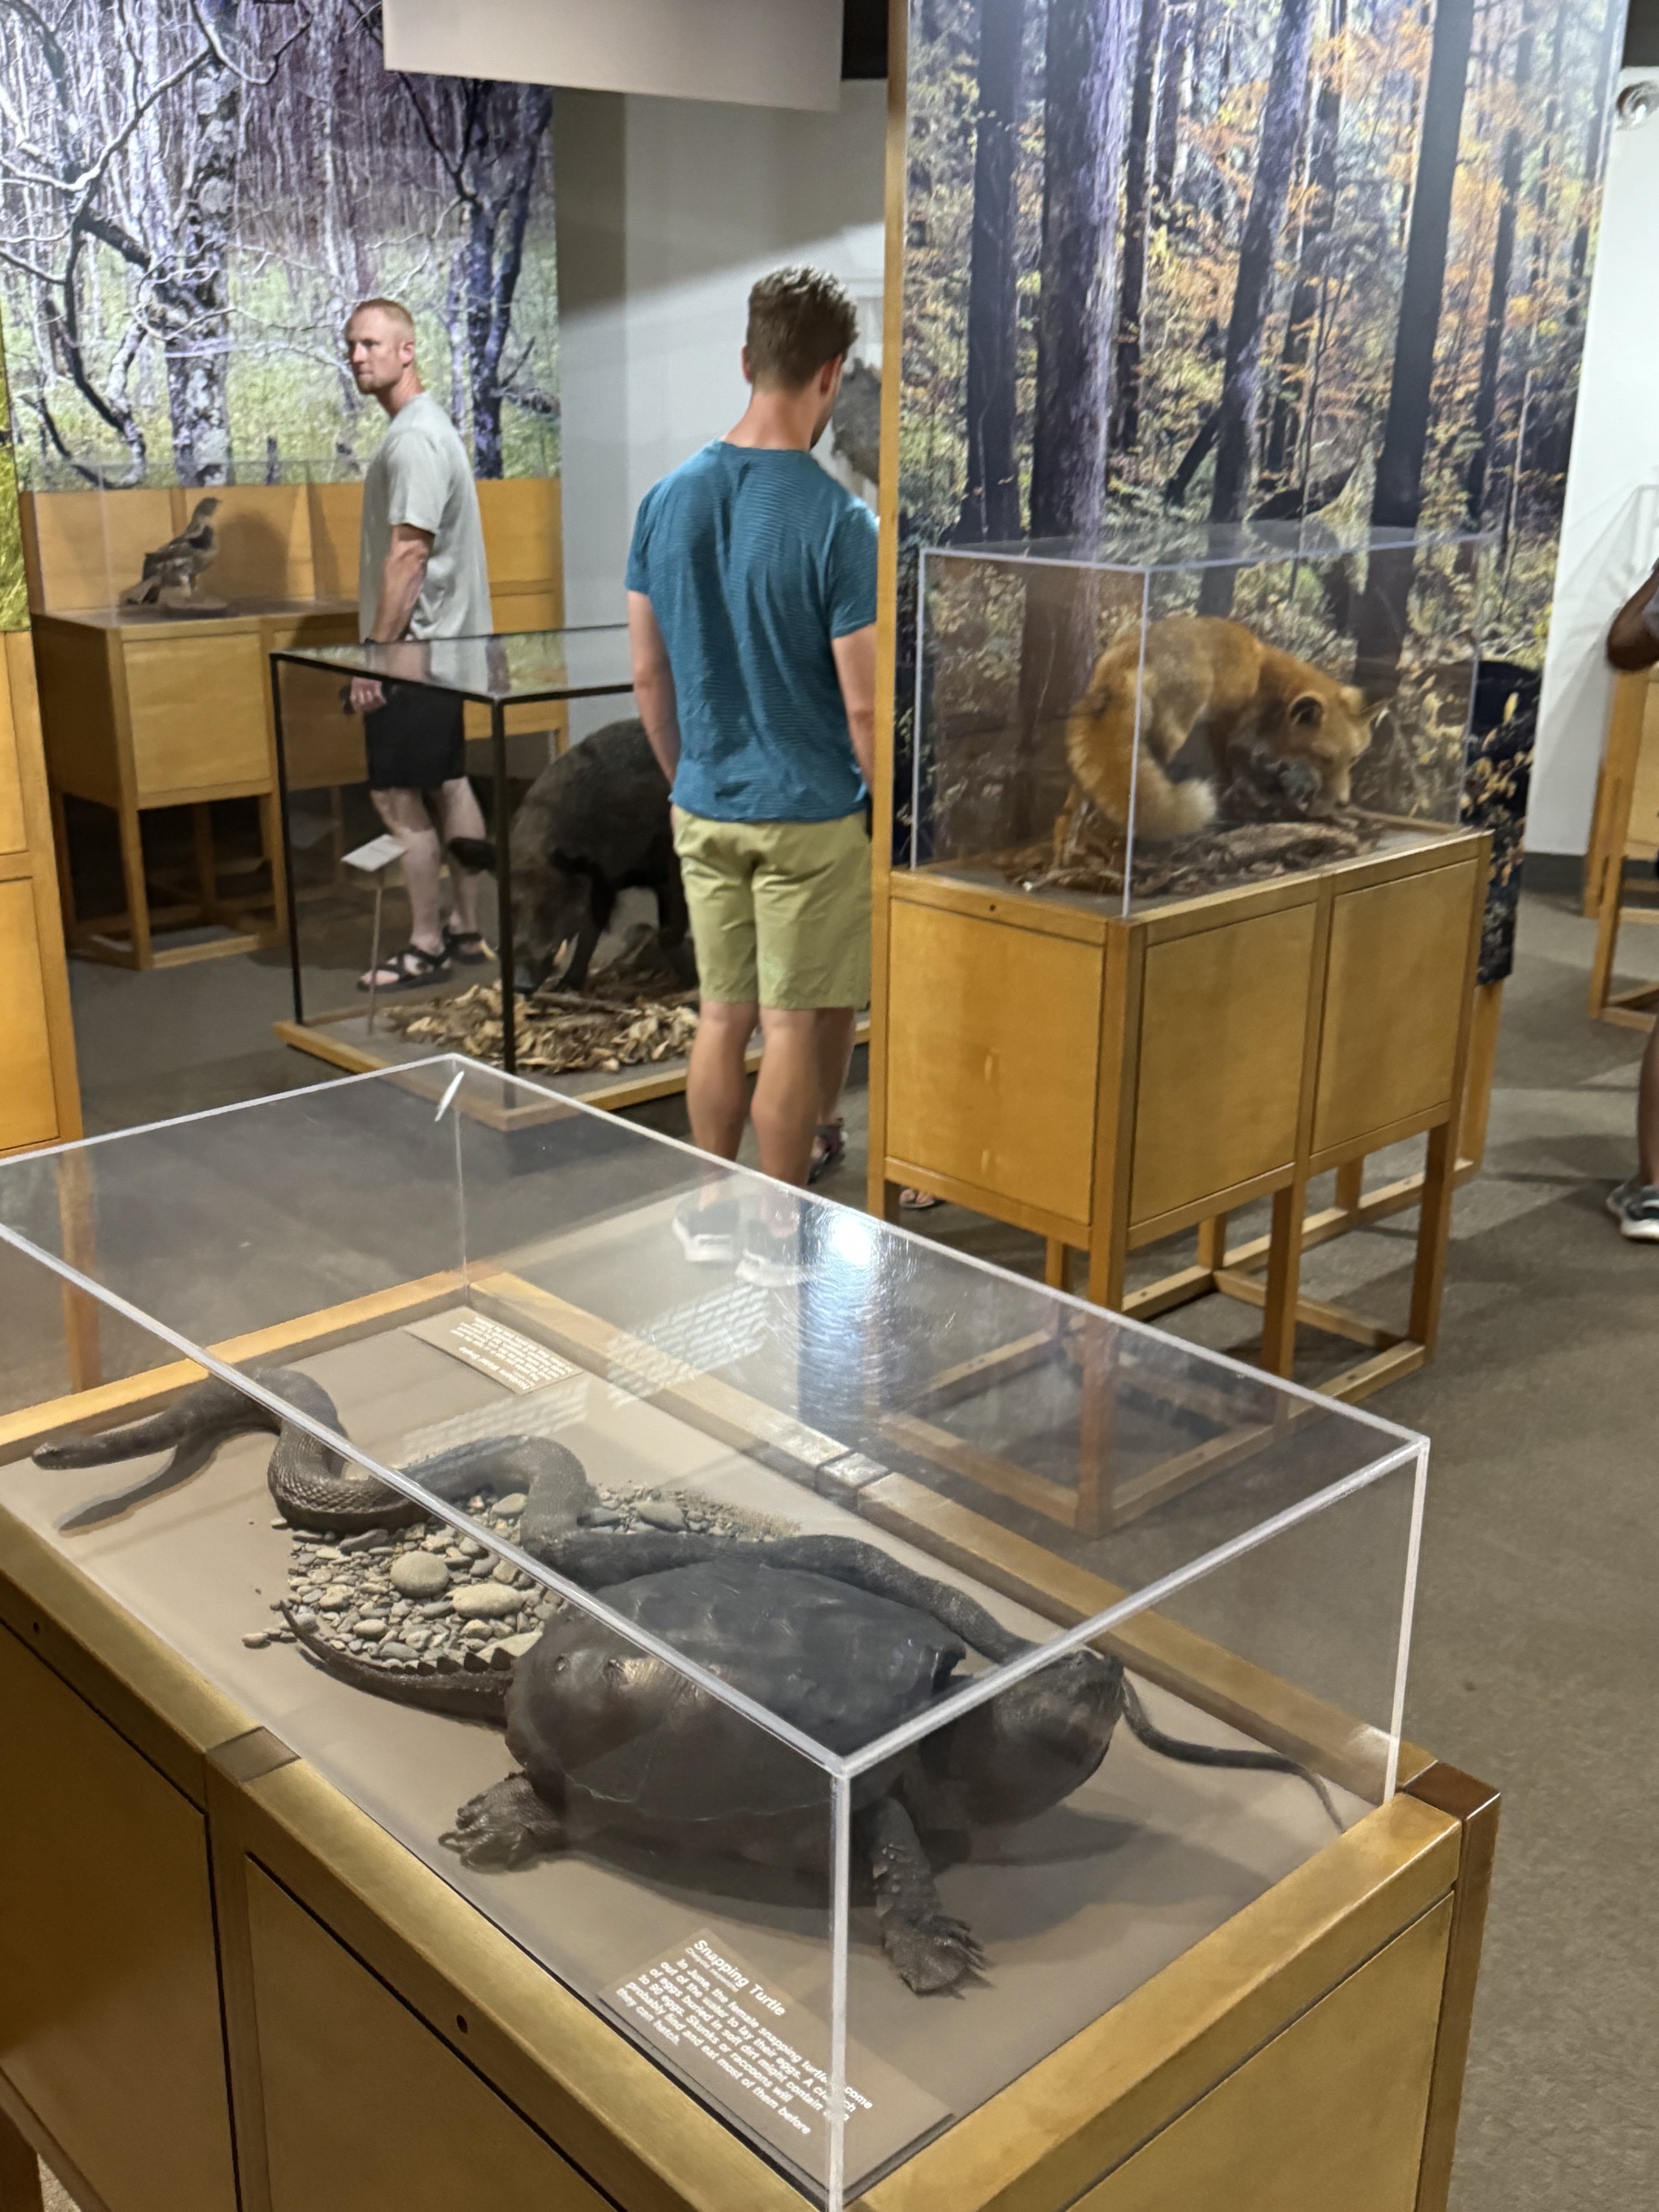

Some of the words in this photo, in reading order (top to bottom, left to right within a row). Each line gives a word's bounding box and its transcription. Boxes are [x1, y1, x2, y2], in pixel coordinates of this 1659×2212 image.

[616, 1988, 638, 2007] they
[636, 2005, 655, 2022] can
[638, 1974, 650, 1985] to
[685, 2014, 720, 2044] Skunks
[719, 2043, 732, 2053] or
[730, 2052, 773, 2088] raccoons
[772, 2086, 794, 2103] will
[649, 1968, 664, 1979] of
[659, 1977, 684, 1997] eggs
[681, 1995, 714, 2022] buried
[710, 2018, 723, 2031] in
[721, 2029, 743, 2047] soft
[740, 2044, 760, 2060] dirt
[757, 2059, 788, 2083] might
[786, 2081, 824, 2111] contain
[660, 1962, 679, 1976] out
[676, 1975, 690, 1985] of
[685, 1983, 703, 1998] the
[727, 2017, 740, 2028] to
[737, 2025, 755, 2040] lay
[753, 2038, 778, 2057] their
[775, 2057, 801, 2080] eggs.
[802, 2078, 814, 2088] A
[693, 1940, 749, 1988] Snapping
[749, 1984, 786, 2016] Turtle
[625, 1981, 667, 2015] probably
[681, 2030, 705, 2047] and
[701, 2045, 720, 2060] eat
[716, 2058, 744, 2080] most
[740, 2077, 756, 2089] of
[752, 2086, 779, 2109] them
[777, 2107, 811, 2134] before
[710, 1988, 728, 2003] the
[758, 2027, 803, 2063] snapping
[844, 2086, 873, 2109] come
